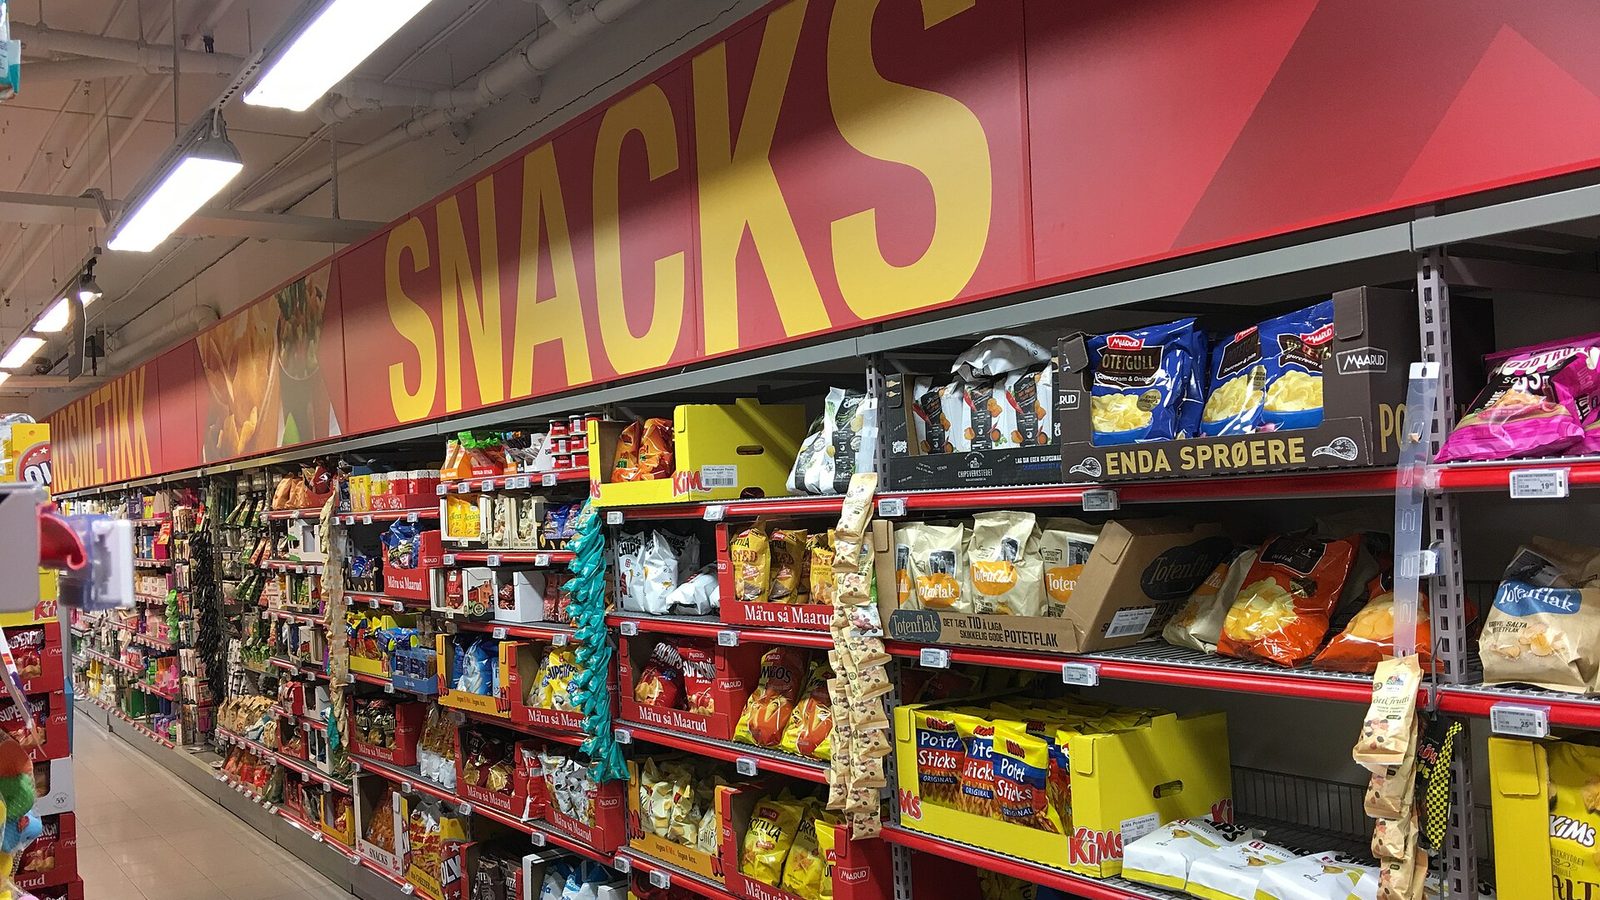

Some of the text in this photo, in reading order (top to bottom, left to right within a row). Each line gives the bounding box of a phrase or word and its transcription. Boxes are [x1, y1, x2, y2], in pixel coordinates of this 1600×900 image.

[385, 0, 992, 423] SNACKS
[1343, 354, 1385, 368] MAARUD
[51, 367, 152, 493] KOSMETIKK
[1106, 438, 1306, 475] ENDA SPRØERE
[778, 606, 789, 623] så
[943, 618, 954, 627] DET
[967, 616, 981, 630] TID
[988, 622, 1002, 631] LAGA
[892, 614, 938, 636] Totenflak
[960, 630, 988, 641] SKIKKELIG
[1004, 630, 1058, 647] POTETFLAK
[673, 712, 707, 732] Maarud
[918, 750, 957, 769] Sticks
[1001, 758, 1025, 782] Potet
[997, 780, 1032, 802] Sticks
[369, 848, 388, 866] SNACKS
